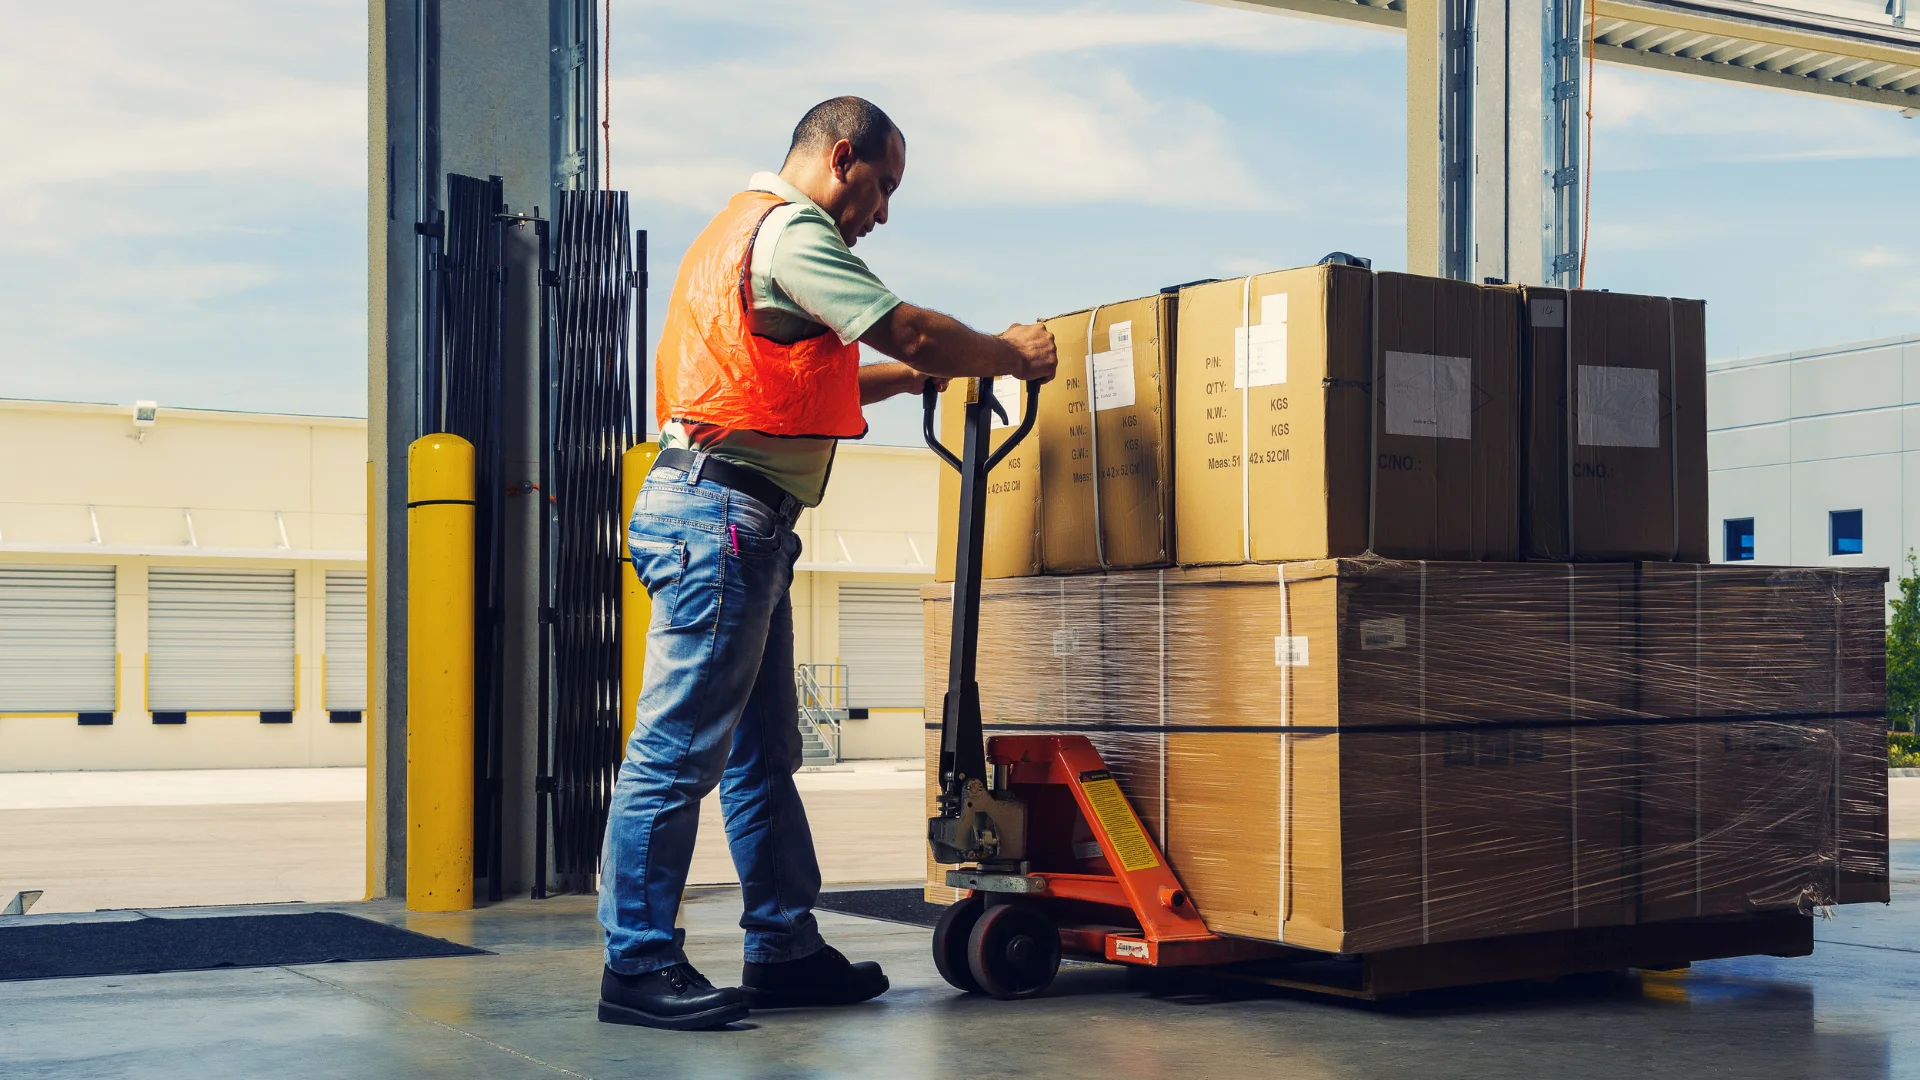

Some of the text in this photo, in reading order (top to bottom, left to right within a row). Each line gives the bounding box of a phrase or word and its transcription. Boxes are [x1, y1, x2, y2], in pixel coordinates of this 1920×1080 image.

[1206, 356, 1222, 370] P/N:
[1206, 380, 1227, 394] Q'TY:
[1206, 397, 1289, 420] N.W.: KGS
[1122, 414, 1138, 428] KGS
[1207, 422, 1290, 444] G.W.: KGS
[1071, 439, 1139, 460] G.W.: KGS
[1008, 458, 1021, 470] KGS
[1208, 457, 1231, 470] Meas:
[1072, 472, 1092, 484] Meas:
